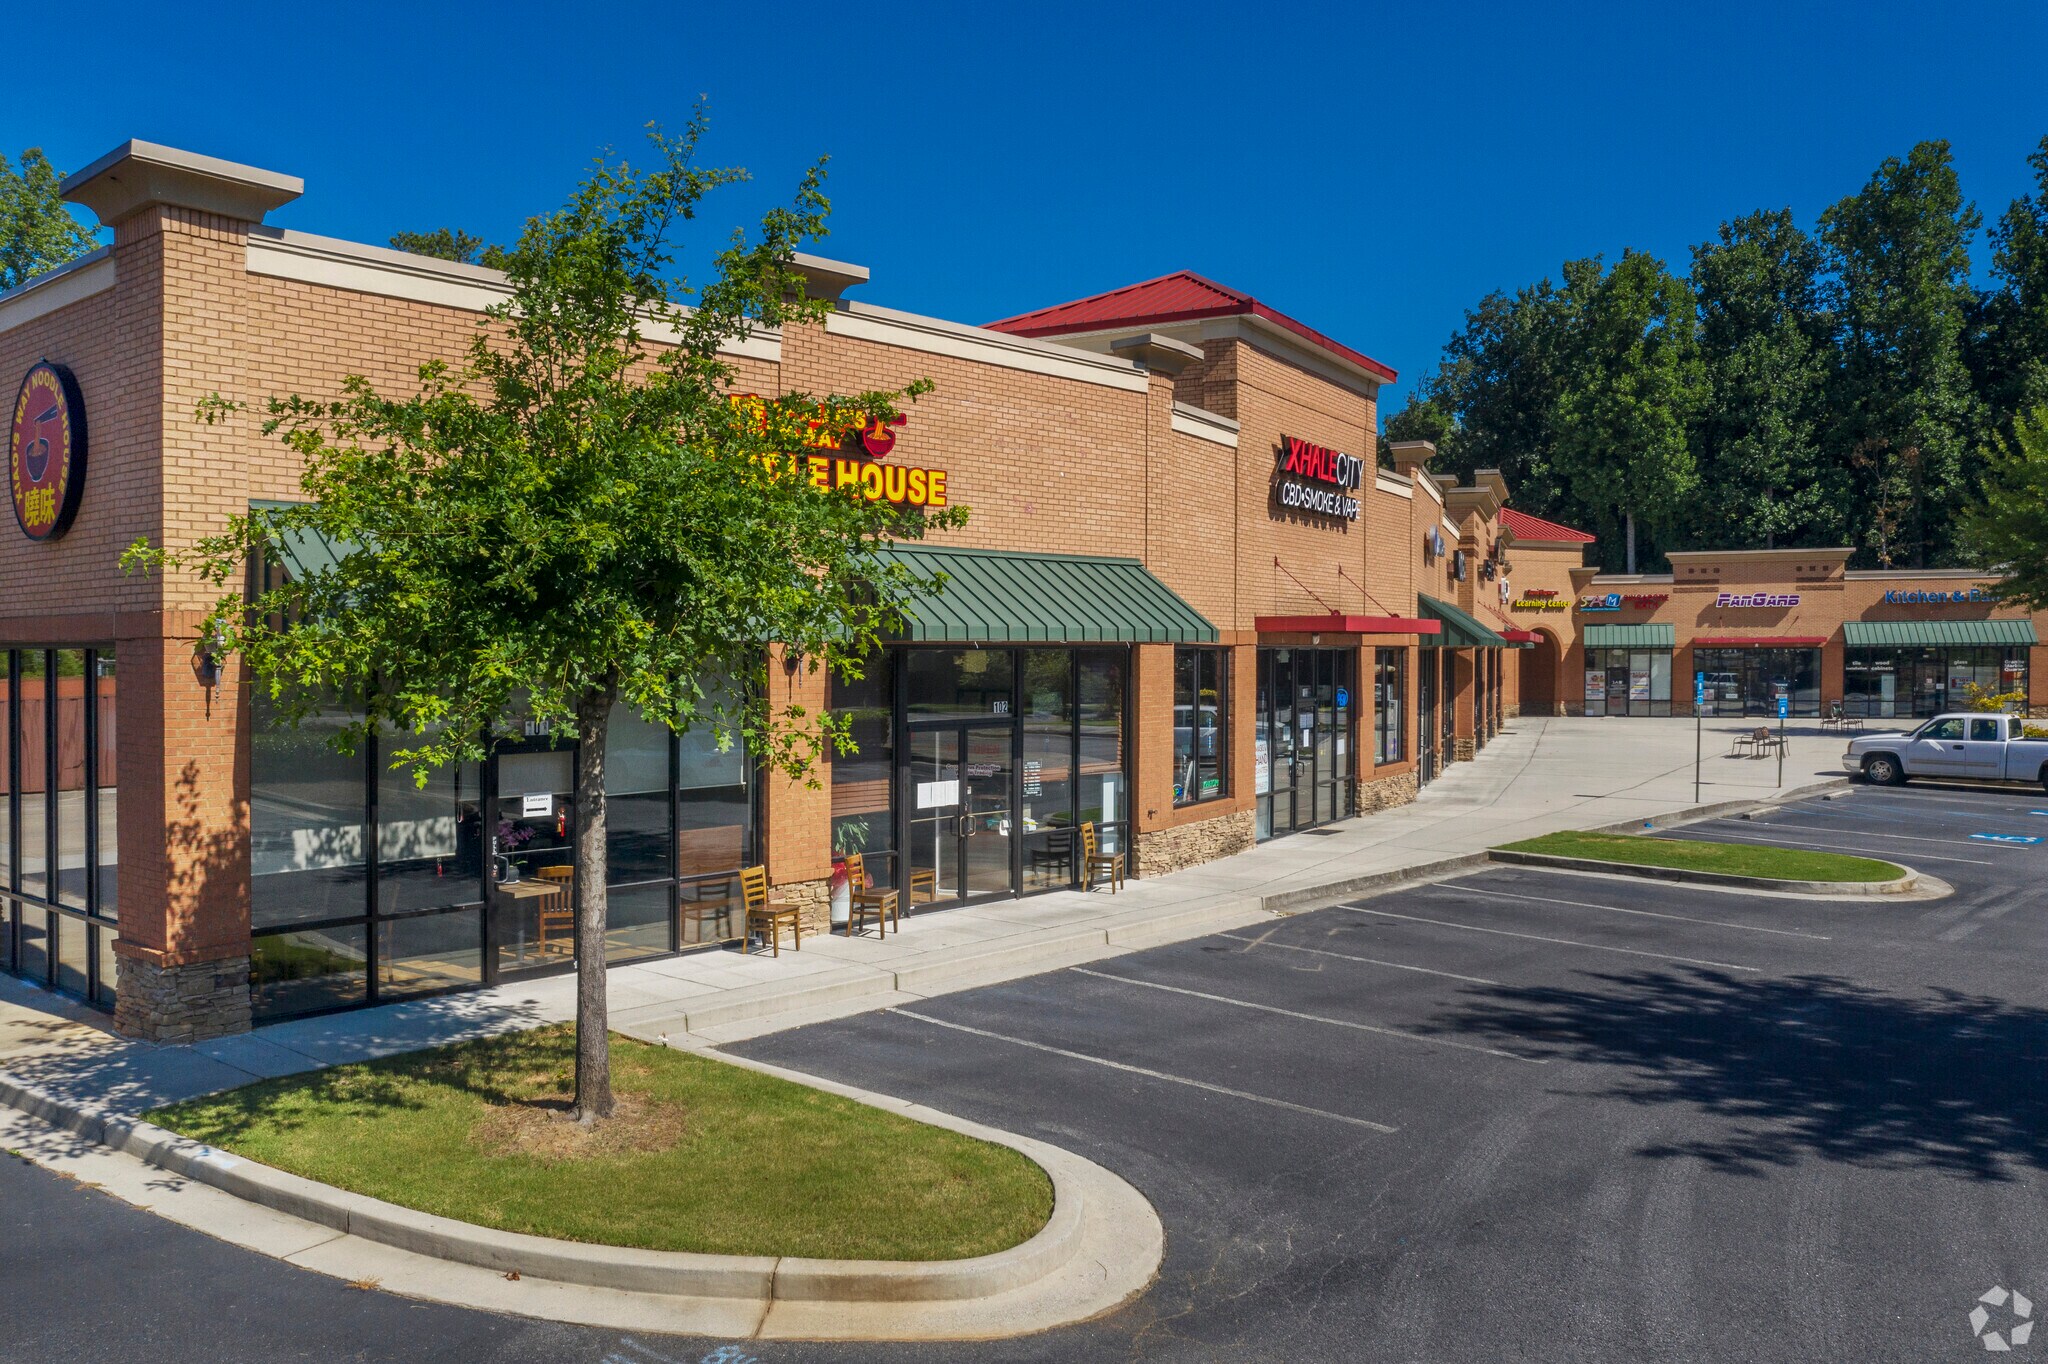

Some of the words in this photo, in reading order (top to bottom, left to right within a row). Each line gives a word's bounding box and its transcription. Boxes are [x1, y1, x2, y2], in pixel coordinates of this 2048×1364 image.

[16, 387, 31, 425] WAY
[32, 370, 65, 411] NOODLE
[58, 415, 71, 495] HOUSE
[836, 457, 947, 507] HOUSE
[1334, 496, 1341, 515] &
[1342, 497, 1361, 519] VAPE
[1516, 599, 1546, 609] Learning
[1547, 599, 1571, 607] Center
[1581, 594, 1620, 607] SAM
[1885, 589, 1947, 604] Kitchen
[1951, 590, 1965, 603] &
[994, 701, 1008, 713] 102
